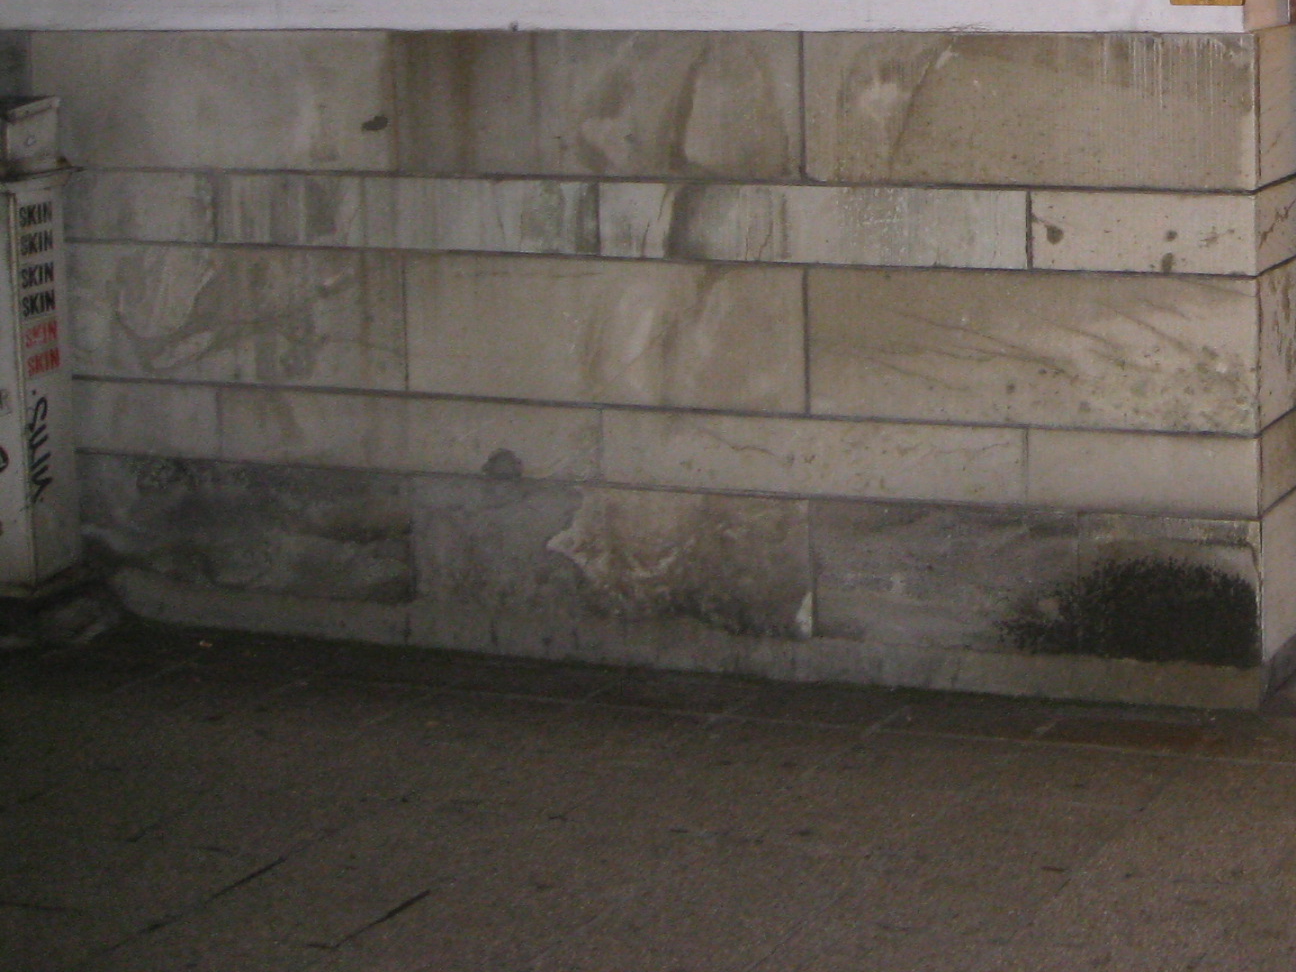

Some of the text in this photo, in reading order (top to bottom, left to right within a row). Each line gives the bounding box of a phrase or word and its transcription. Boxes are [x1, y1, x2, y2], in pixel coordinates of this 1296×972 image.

[19, 201, 52, 227] SKIN
[20, 229, 54, 256] SKIN
[20, 262, 55, 289] SKIN
[21, 289, 56, 318] SKIN
[27, 346, 61, 377] SKIN
